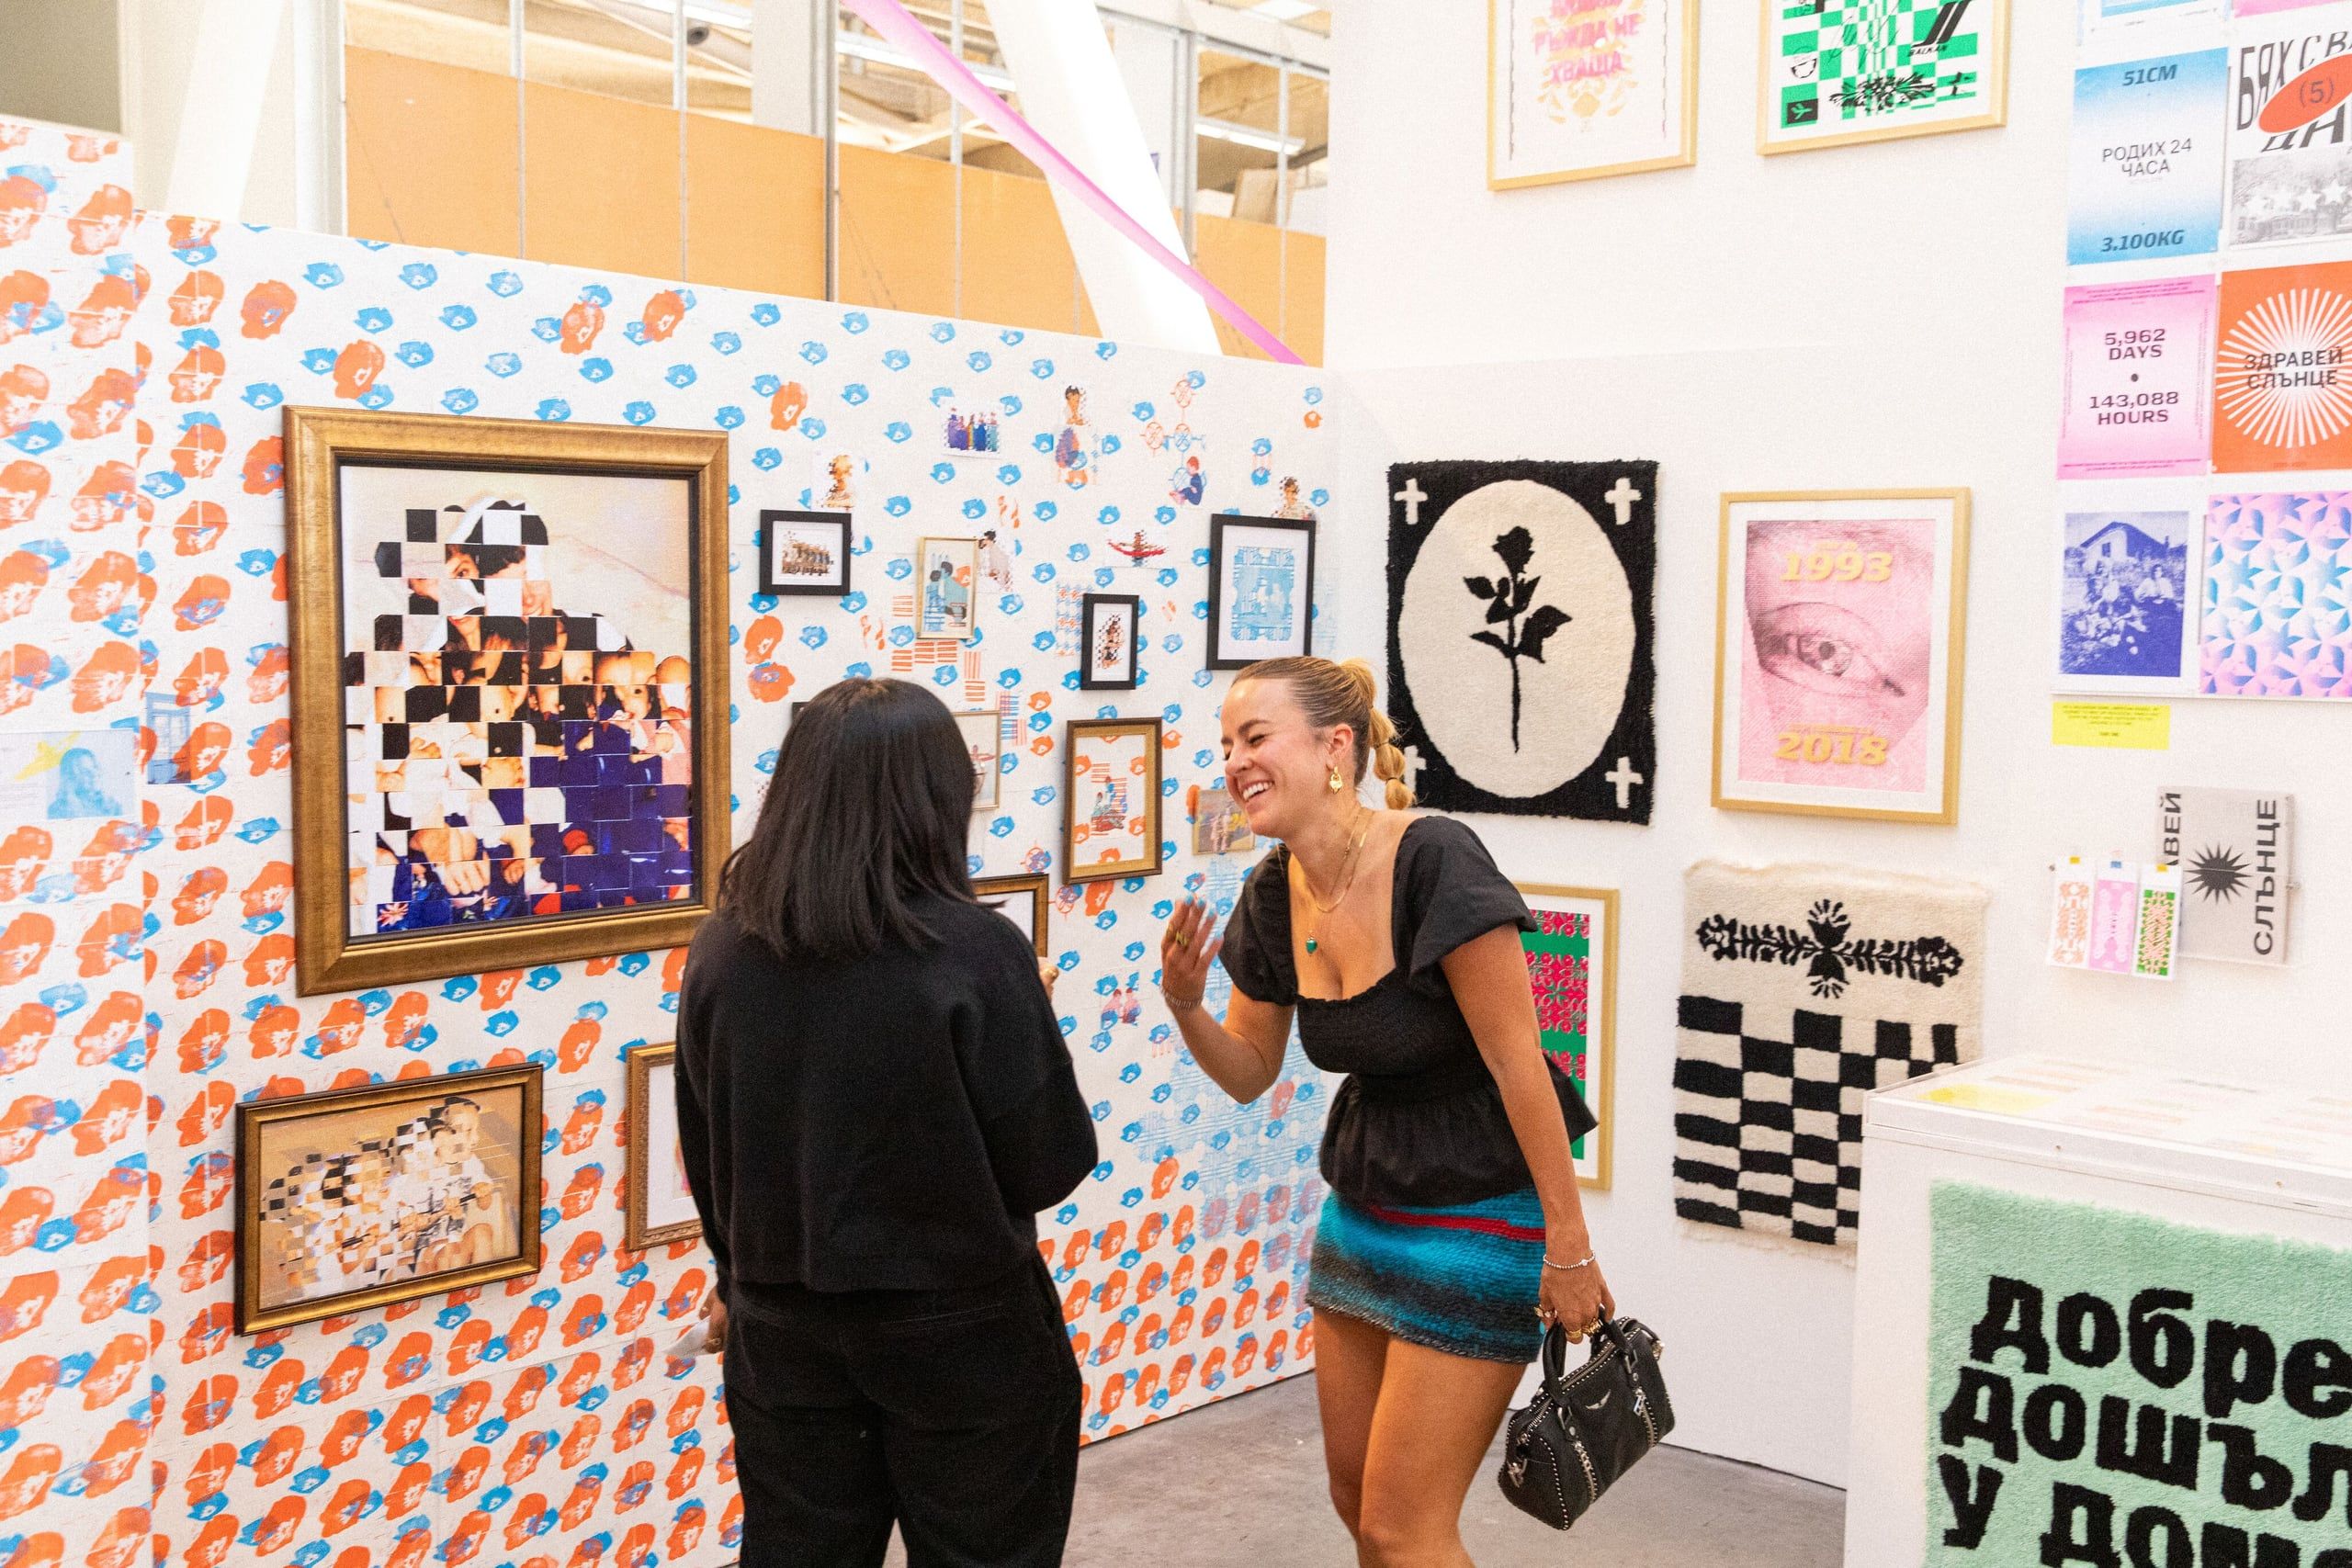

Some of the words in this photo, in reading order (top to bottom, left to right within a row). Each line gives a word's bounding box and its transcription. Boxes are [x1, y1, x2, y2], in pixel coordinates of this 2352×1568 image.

[1550, 51, 1625, 85] ХВАЩА
[2300, 77, 2335, 107] (5)
[2102, 141, 2165, 163] РОДИХ
[2171, 138, 2192, 154] 24
[2121, 159, 2170, 177] ЧАСА
[2101, 230, 2185, 253] 3.100KG
[2105, 328, 2165, 345] 5,962
[2109, 344, 2163, 360] DAYS
[2245, 346, 2343, 371] ЗДРАВЕЙ
[2247, 369, 2337, 389] СЛЪНЦЕ
[2089, 391, 2179, 409] 143,088
[2098, 410, 2169, 425] HOURS
[1779, 551, 1893, 582] 1993
[1773, 730, 1889, 765] 2018
[2254, 799, 2280, 955] СЛЪНЦЕ
